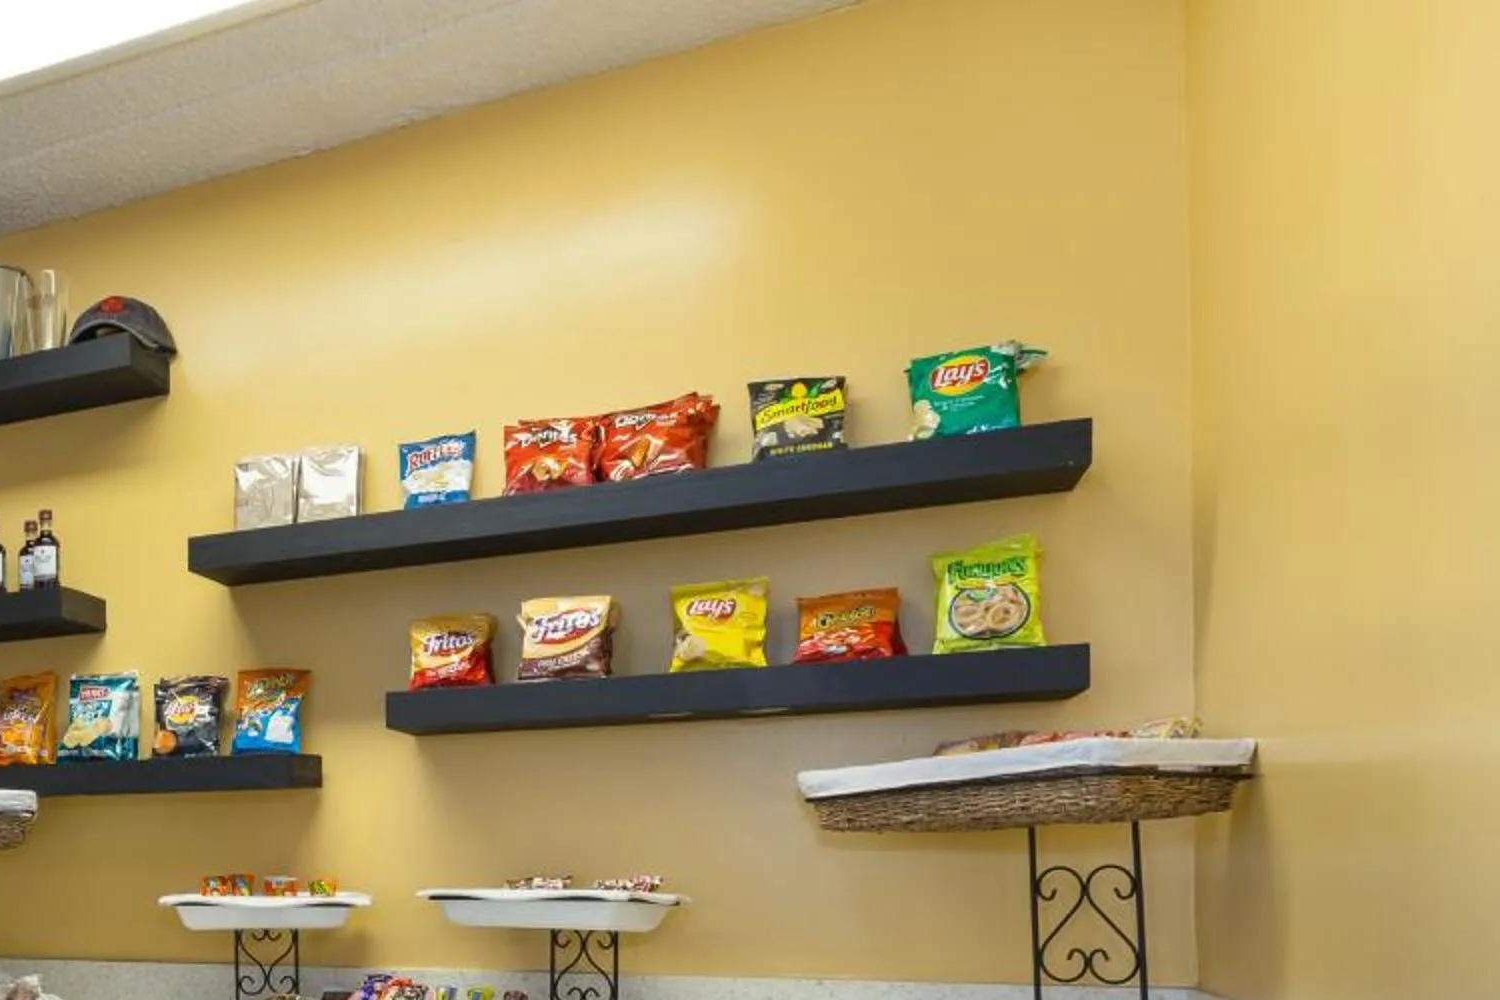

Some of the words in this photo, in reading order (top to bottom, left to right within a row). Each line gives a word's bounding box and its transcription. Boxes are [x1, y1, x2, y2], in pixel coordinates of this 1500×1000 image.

[933, 361, 988, 388] Lay's
[760, 395, 838, 423] Smartfood
[688, 598, 736, 618] Lay's
[532, 608, 601, 640] Fritos
[424, 632, 477, 652] Fritos
